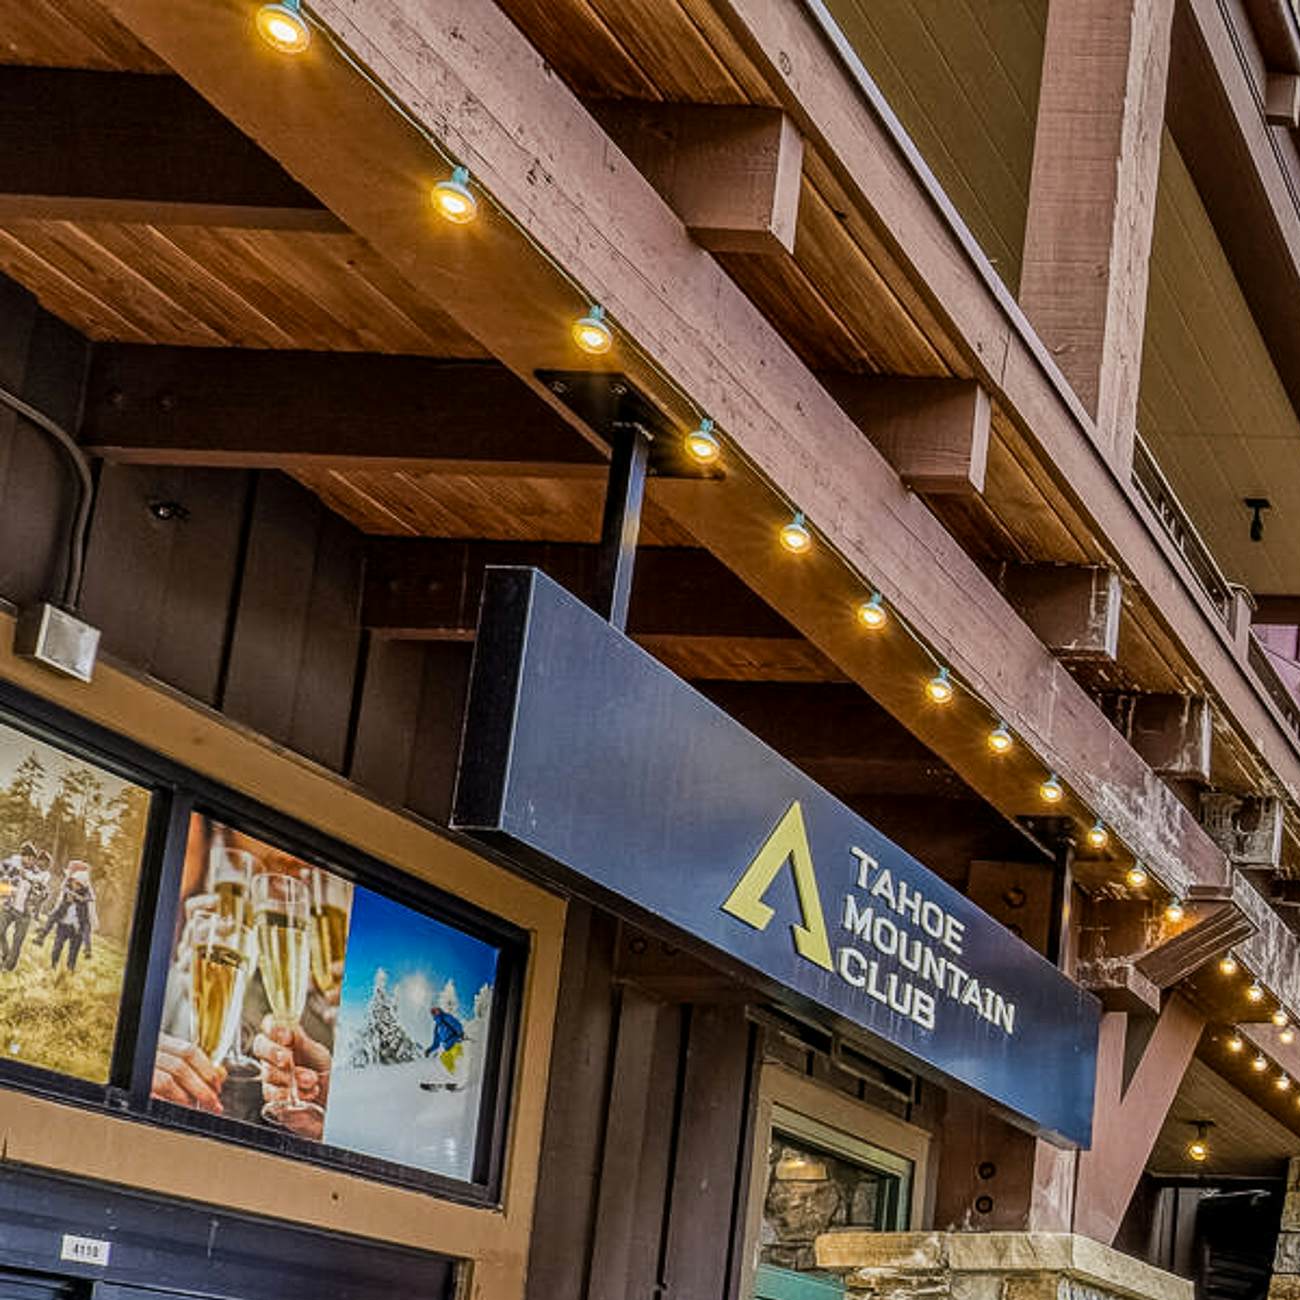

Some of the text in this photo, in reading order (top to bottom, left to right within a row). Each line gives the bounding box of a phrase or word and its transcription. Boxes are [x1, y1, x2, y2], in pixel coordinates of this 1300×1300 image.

[850, 846, 966, 956] TAHOE
[840, 947, 936, 1030] CLUB
[843, 895, 1016, 1035] MOUNTAIN
